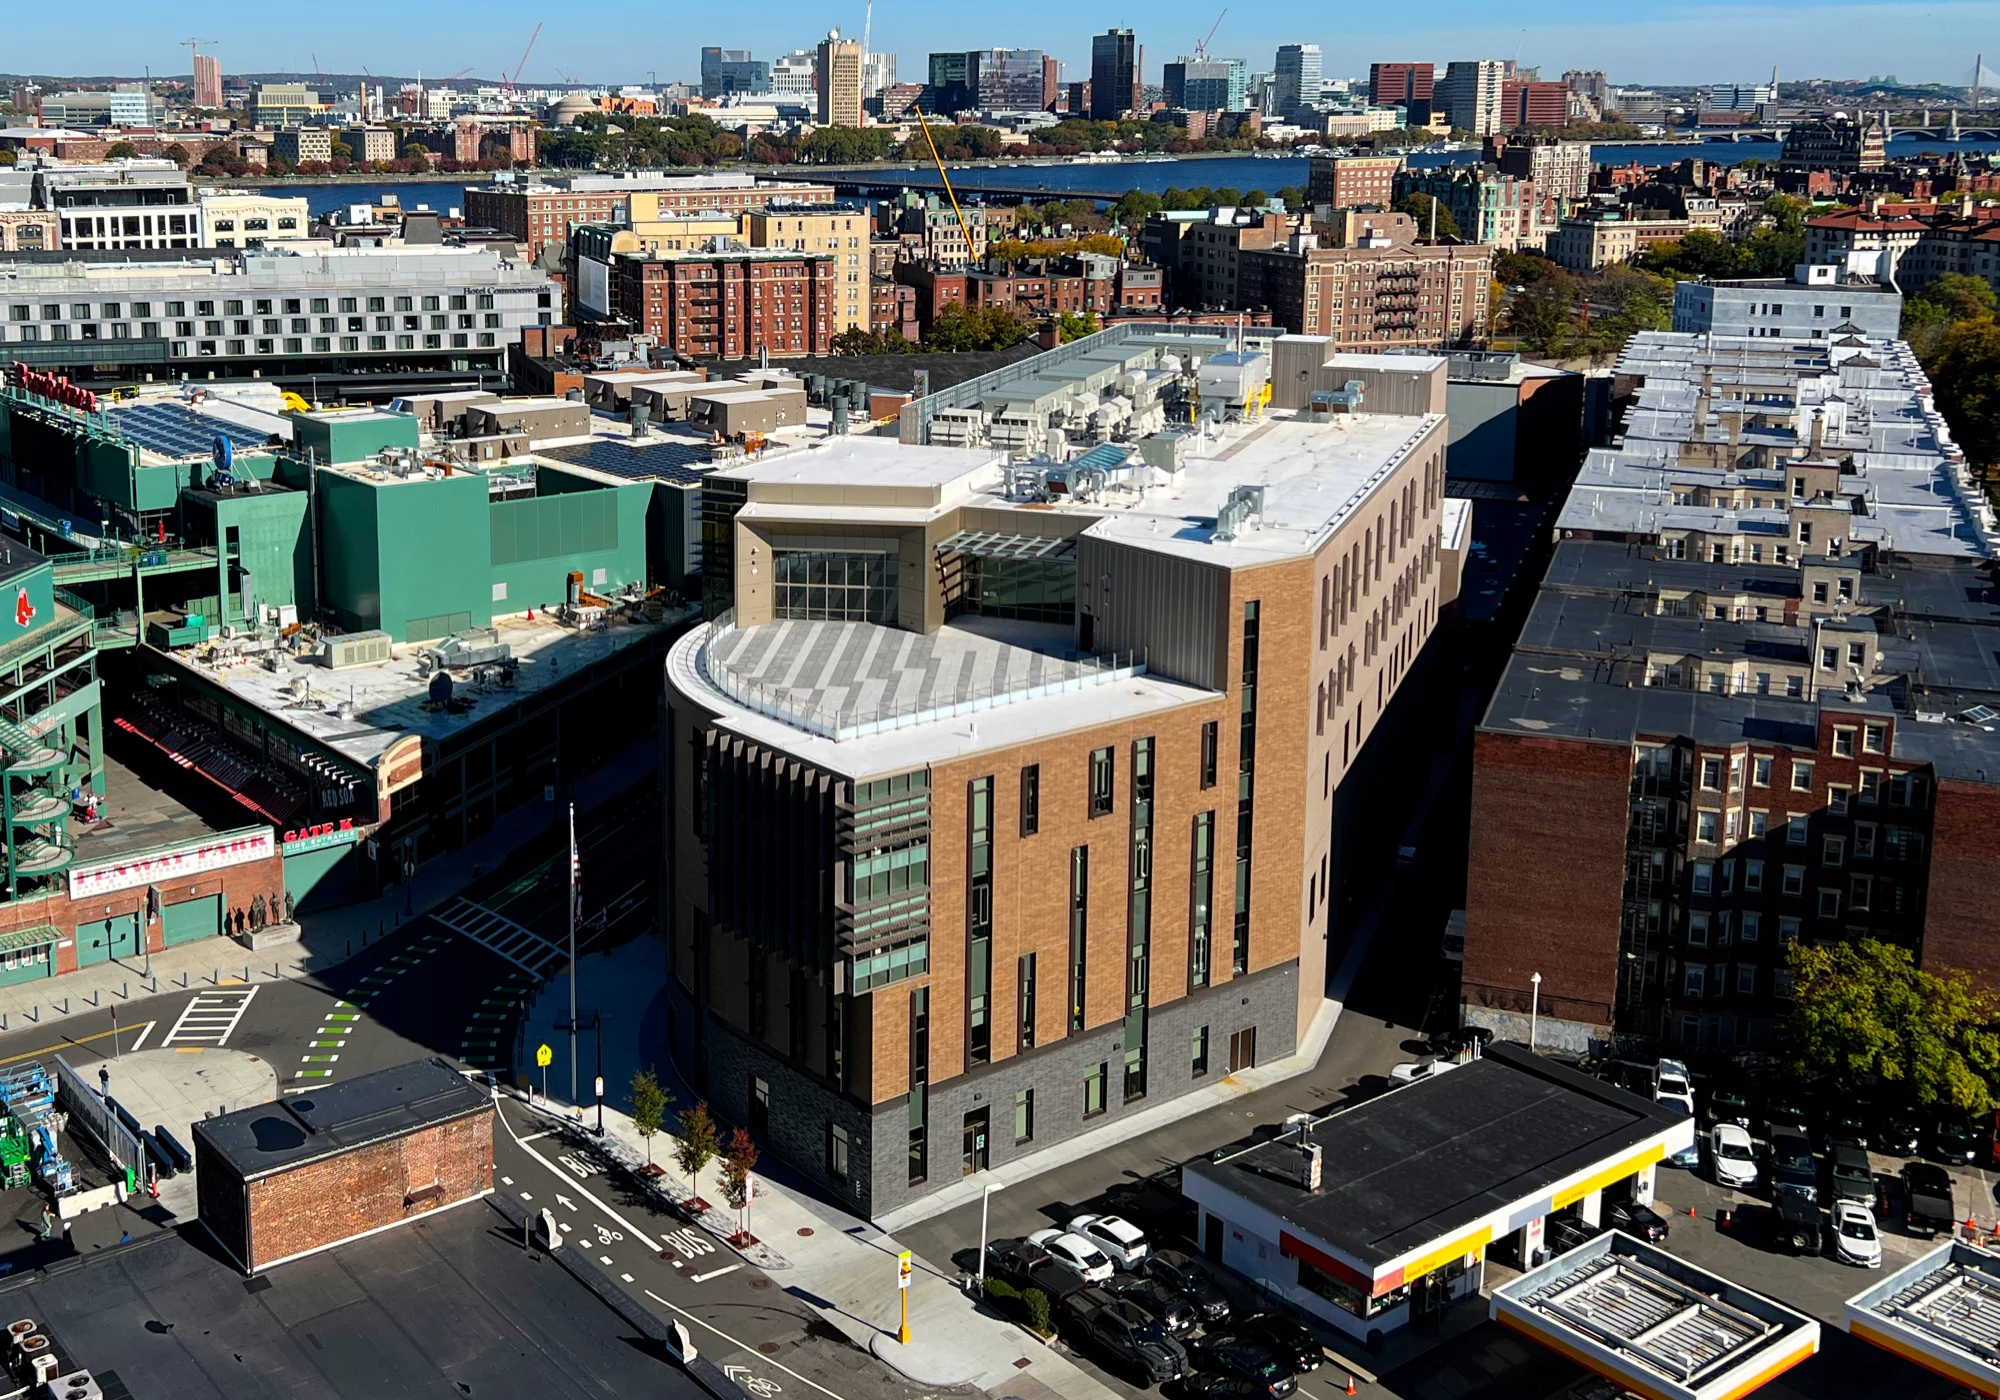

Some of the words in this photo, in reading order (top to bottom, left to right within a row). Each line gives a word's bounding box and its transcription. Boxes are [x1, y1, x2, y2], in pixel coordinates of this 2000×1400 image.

[463, 287, 486, 295] Hotel
[488, 285, 551, 295] Commonwealth
[321, 788, 338, 808] RED
[338, 787, 355, 806] SOX
[284, 822, 334, 843] GATE
[340, 818, 354, 831] K
[286, 842, 306, 850] KIDS
[311, 831, 355, 845] ENTRANCE
[76, 854, 183, 884] FENWAY
[198, 836, 267, 859] PARK
[558, 1150, 608, 1179] BUS
[661, 1227, 716, 1260] BUS
